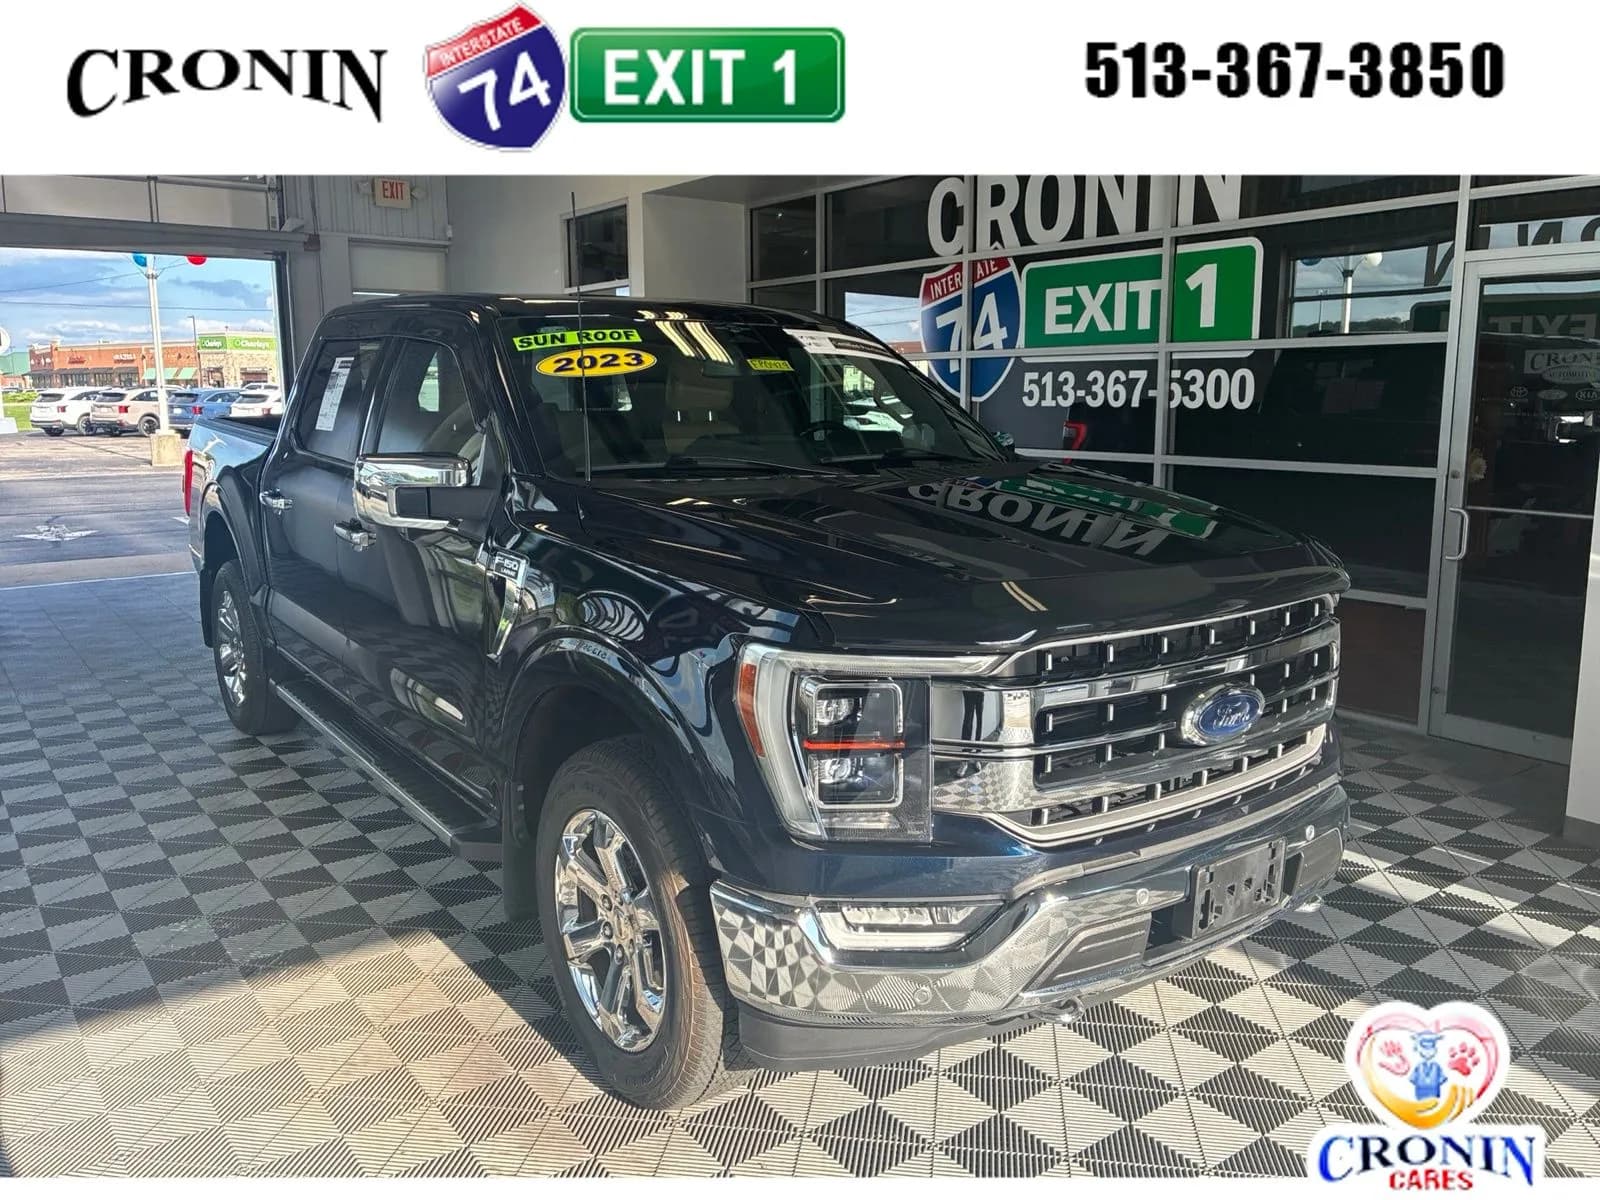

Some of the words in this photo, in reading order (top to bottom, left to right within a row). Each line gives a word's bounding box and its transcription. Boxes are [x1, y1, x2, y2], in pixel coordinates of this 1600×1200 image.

[382, 180, 405, 200] EXIT
[928, 174, 1242, 257] CRONIN
[930, 259, 999, 300] INTERATE
[1044, 279, 1162, 335] EXIT
[1185, 263, 1217, 328] 1
[518, 333, 566, 348] SUN
[577, 330, 635, 342] ROOF
[936, 292, 1008, 373] 74
[553, 352, 645, 373] 2023
[1022, 368, 1255, 410] 513-367-5300
[1213, 702, 1251, 730] Ford
